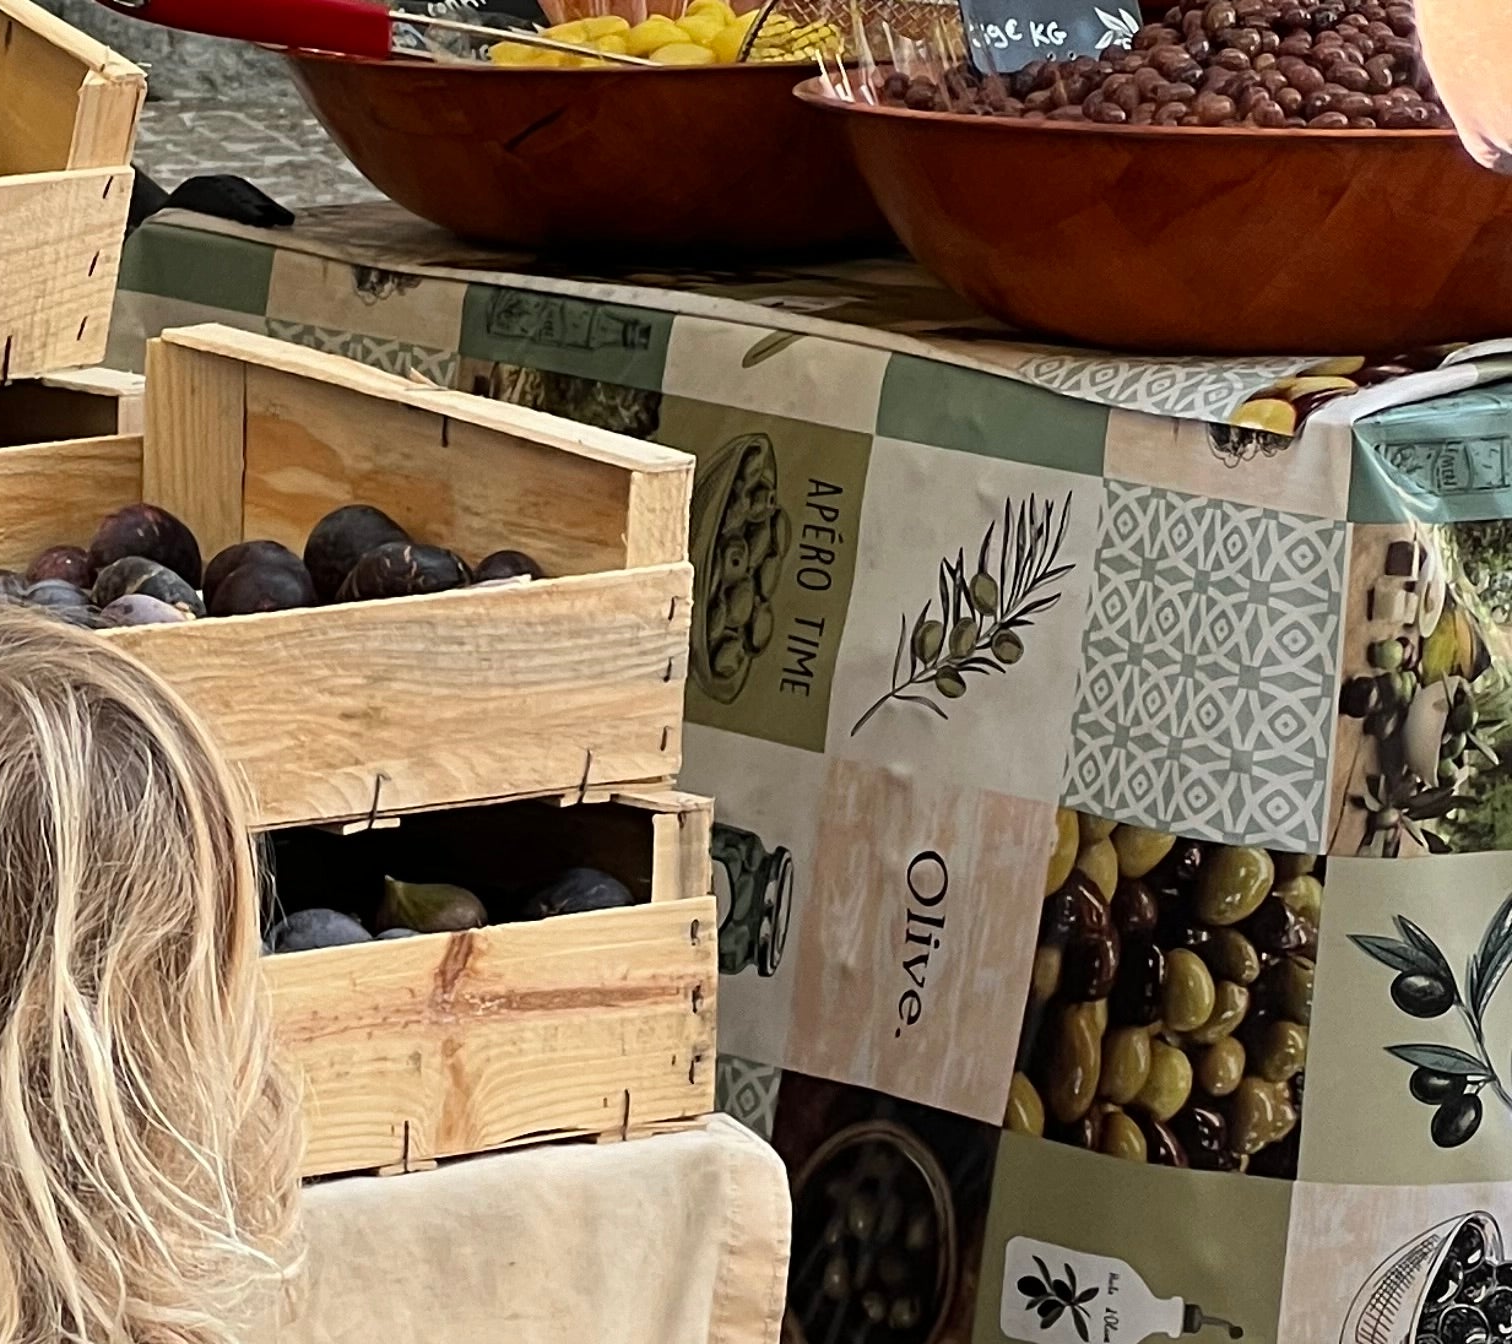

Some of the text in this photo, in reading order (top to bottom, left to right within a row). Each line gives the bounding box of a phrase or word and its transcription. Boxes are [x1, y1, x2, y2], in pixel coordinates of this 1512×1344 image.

[1029, 20, 1068, 48] KG
[779, 477, 844, 698] APÉRO TIME
[894, 850, 949, 1039] Olive.
